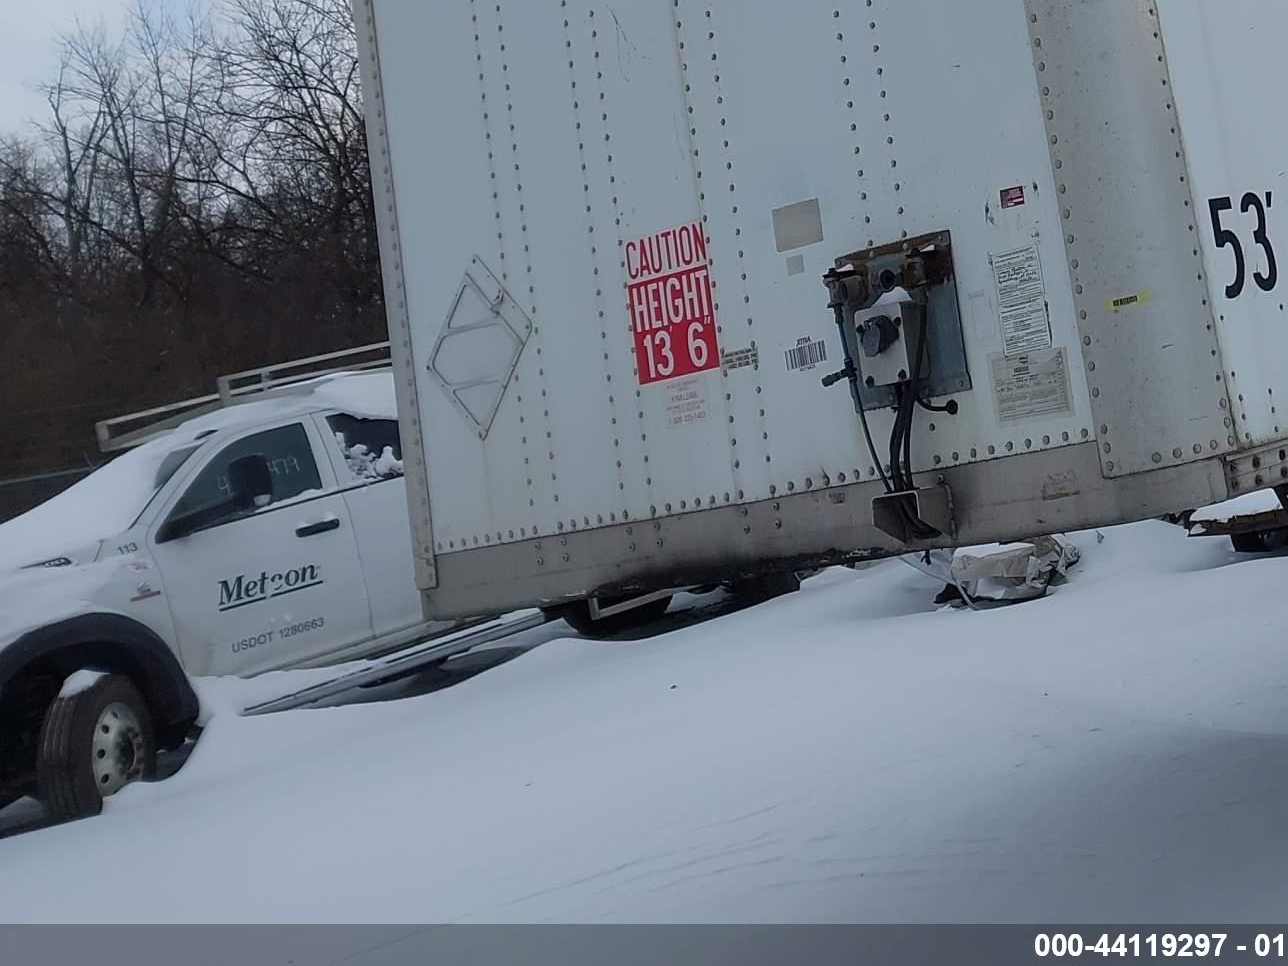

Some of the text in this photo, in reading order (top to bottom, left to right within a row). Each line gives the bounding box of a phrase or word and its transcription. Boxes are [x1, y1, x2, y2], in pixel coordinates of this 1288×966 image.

[626, 222, 707, 279] CAUTION
[1208, 191, 1277, 299] 53'
[632, 269, 709, 332] HEIGHT
[117, 542, 138, 555] 113
[218, 564, 319, 607] Metcon
[231, 617, 325, 653] USDOT 1280663
